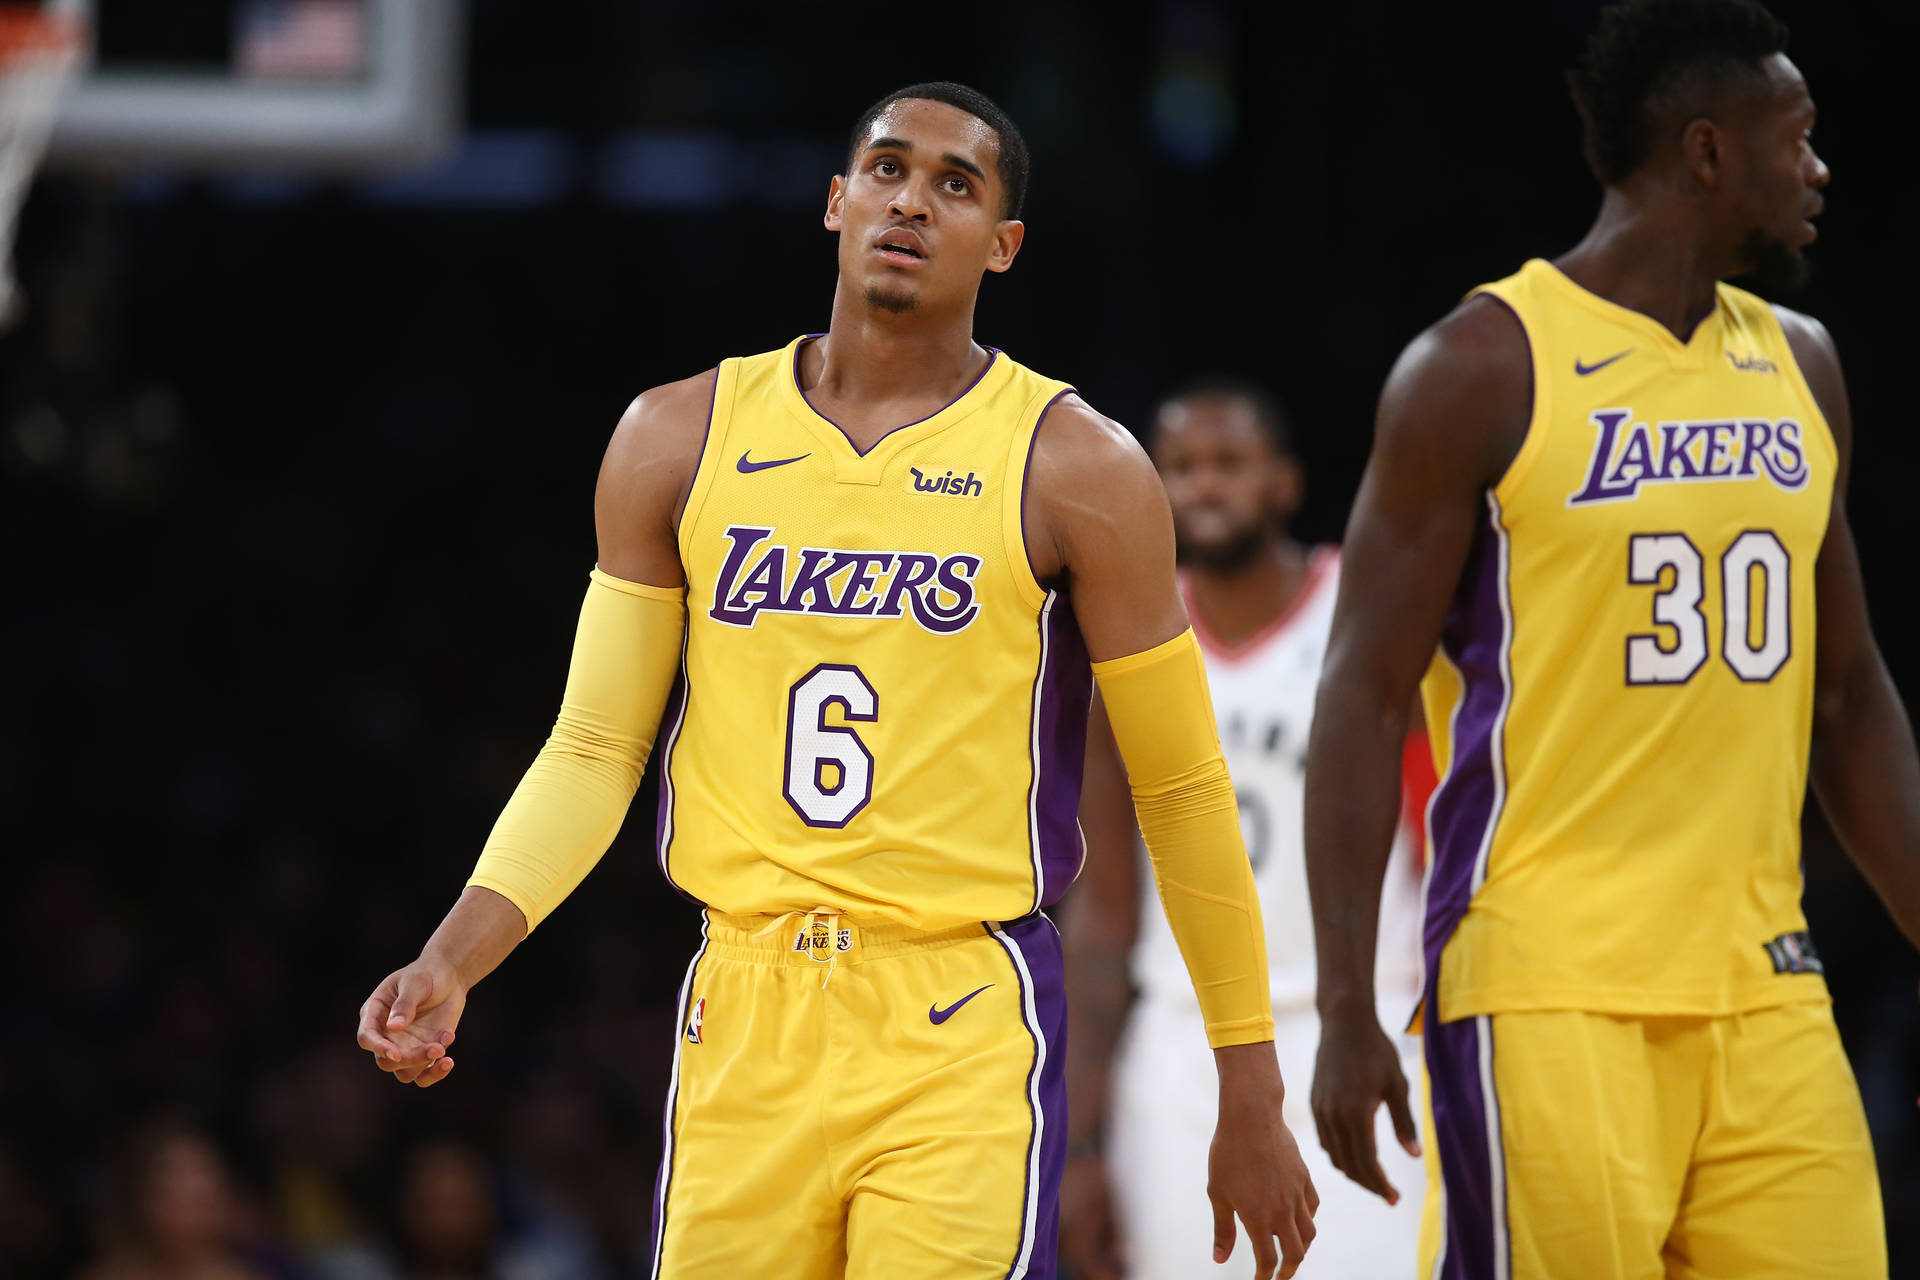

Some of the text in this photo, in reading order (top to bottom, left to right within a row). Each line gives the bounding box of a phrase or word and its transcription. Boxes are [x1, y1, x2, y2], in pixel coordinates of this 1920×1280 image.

[910, 467, 983, 497] wish
[1565, 407, 1811, 509] LAKERS
[708, 524, 984, 636] LAKERS
[1625, 528, 1792, 686] 30
[782, 663, 879, 829] 6
